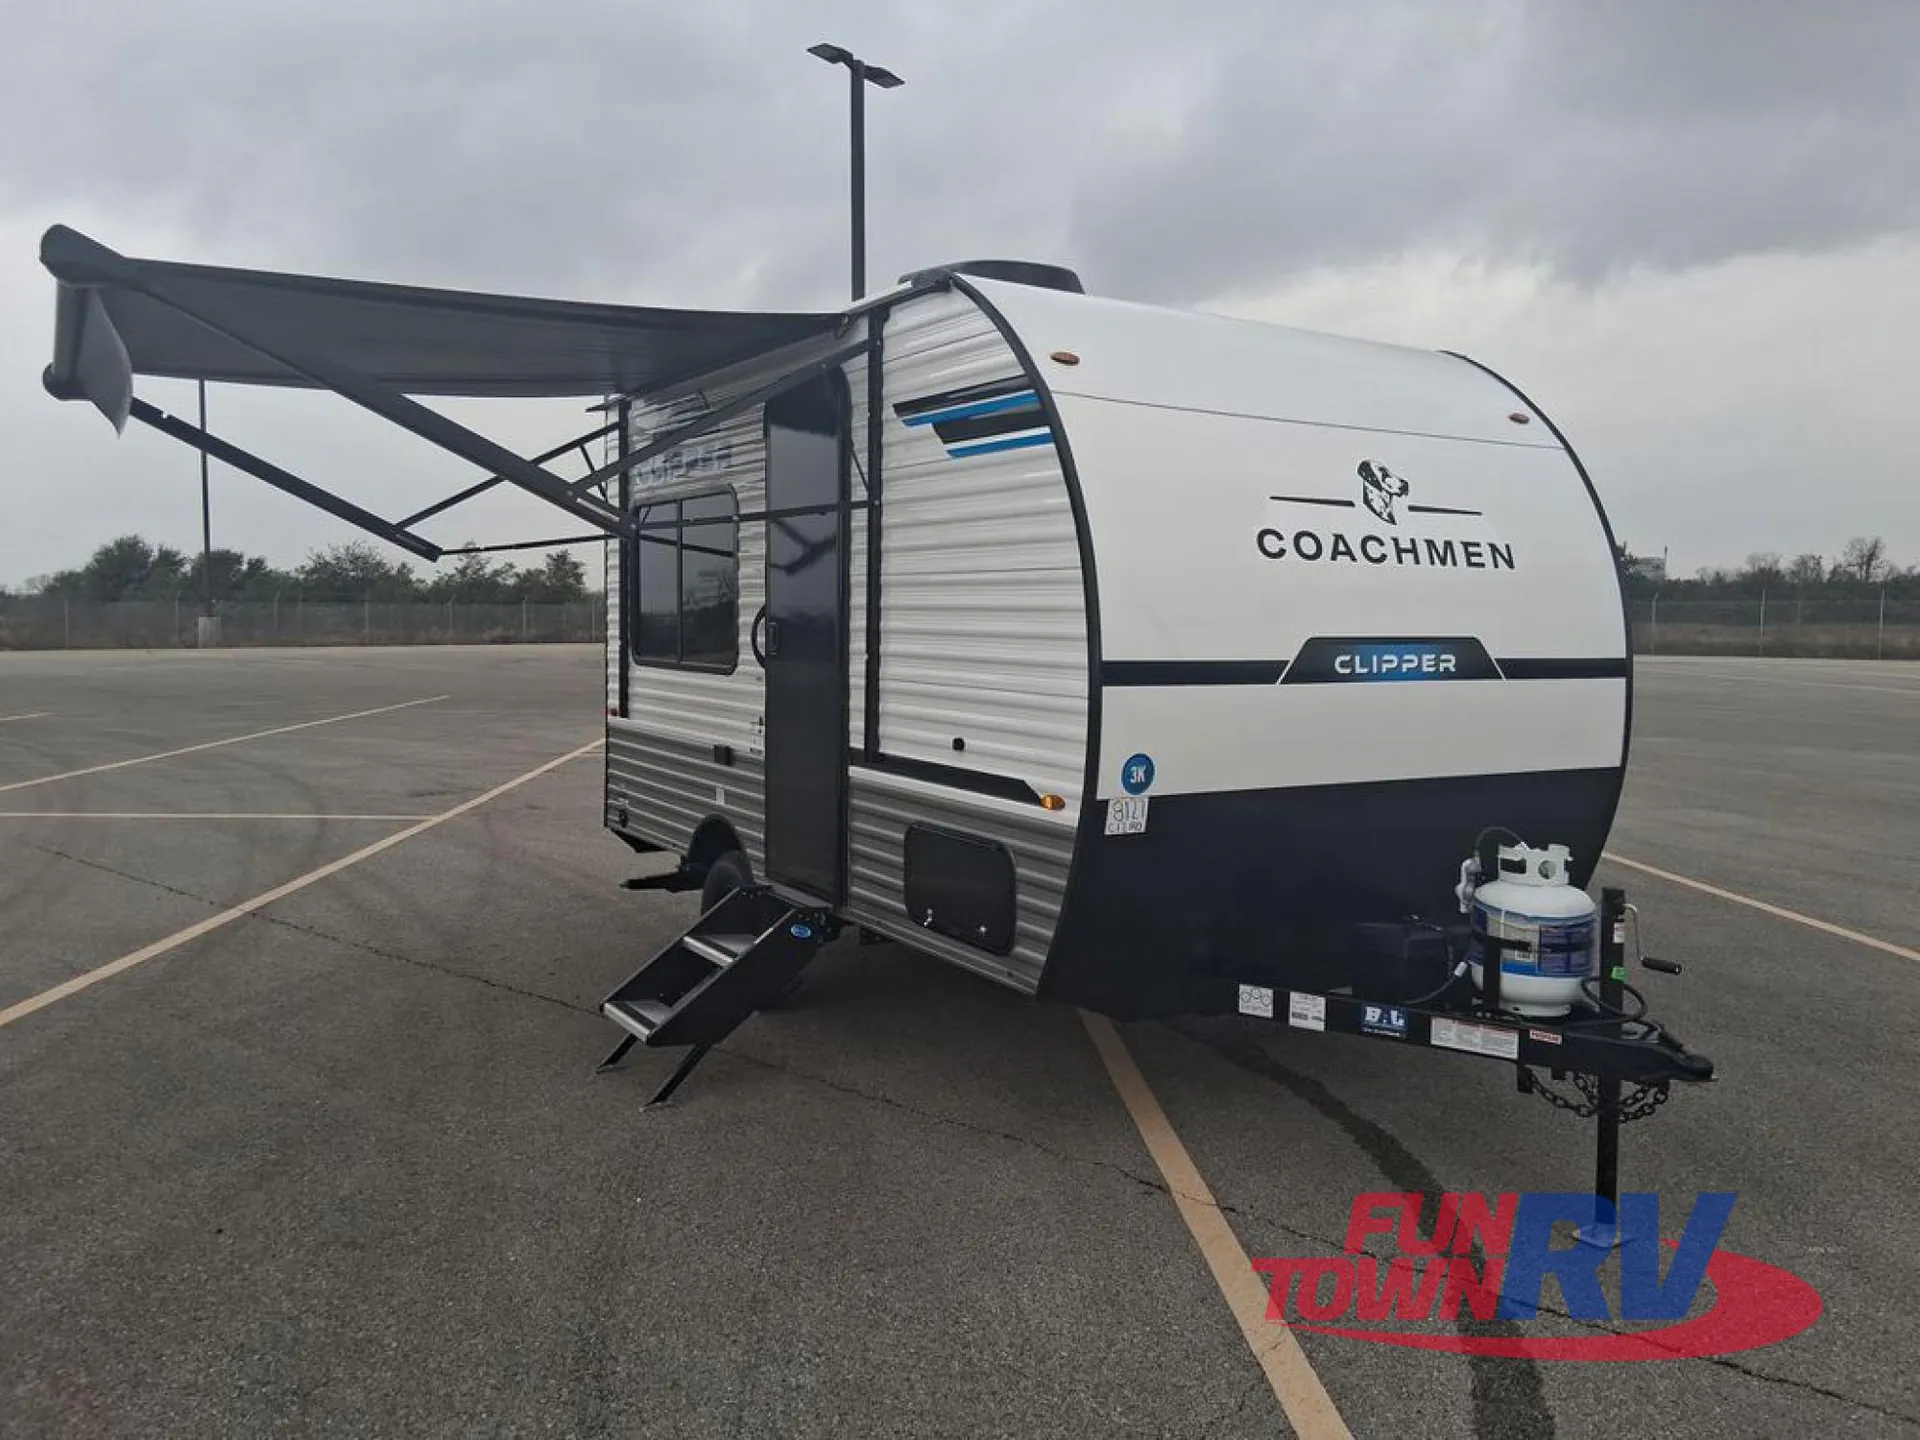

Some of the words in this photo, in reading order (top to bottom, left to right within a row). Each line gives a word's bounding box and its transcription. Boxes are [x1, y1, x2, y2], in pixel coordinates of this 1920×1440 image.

[1256, 528, 1516, 570] COACHMEN
[1334, 654, 1456, 675] CLIPPER
[1130, 764, 1146, 784] 3K
